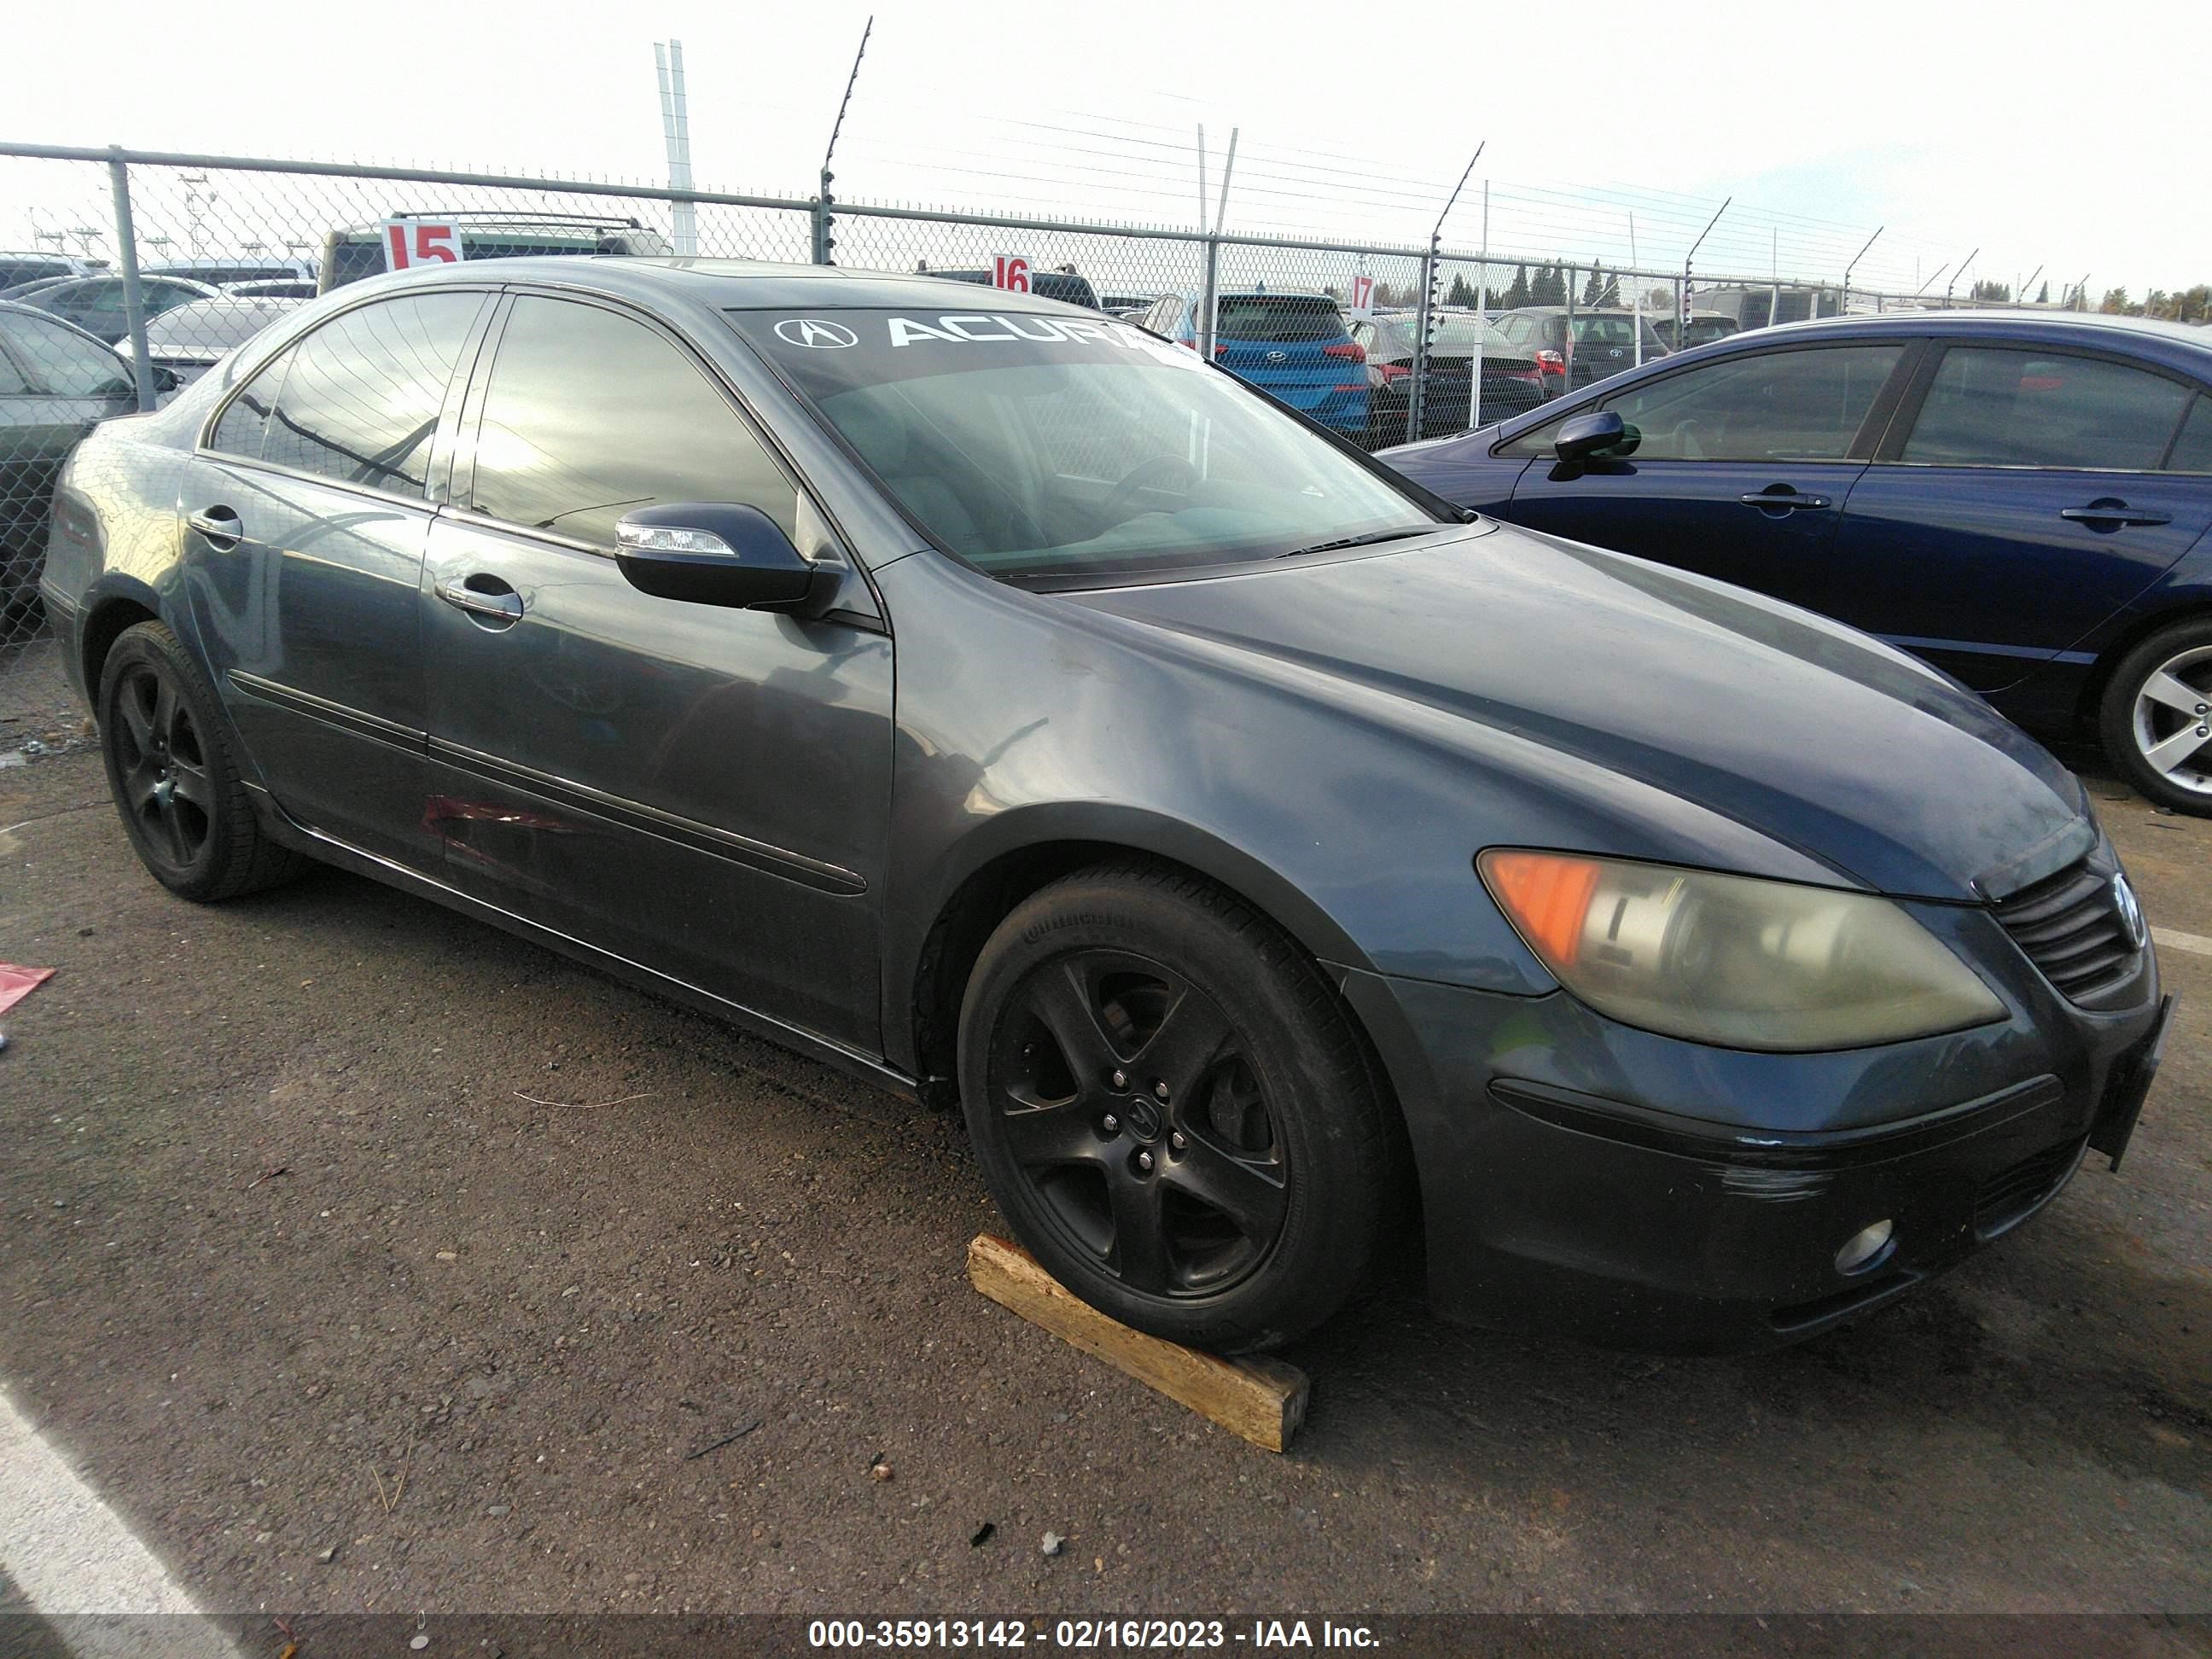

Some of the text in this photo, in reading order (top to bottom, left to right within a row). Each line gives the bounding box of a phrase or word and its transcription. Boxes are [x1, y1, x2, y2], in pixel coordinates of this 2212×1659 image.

[387, 225, 458, 271] 15
[996, 257, 1028, 293] 16
[1353, 276, 1373, 309] 17
